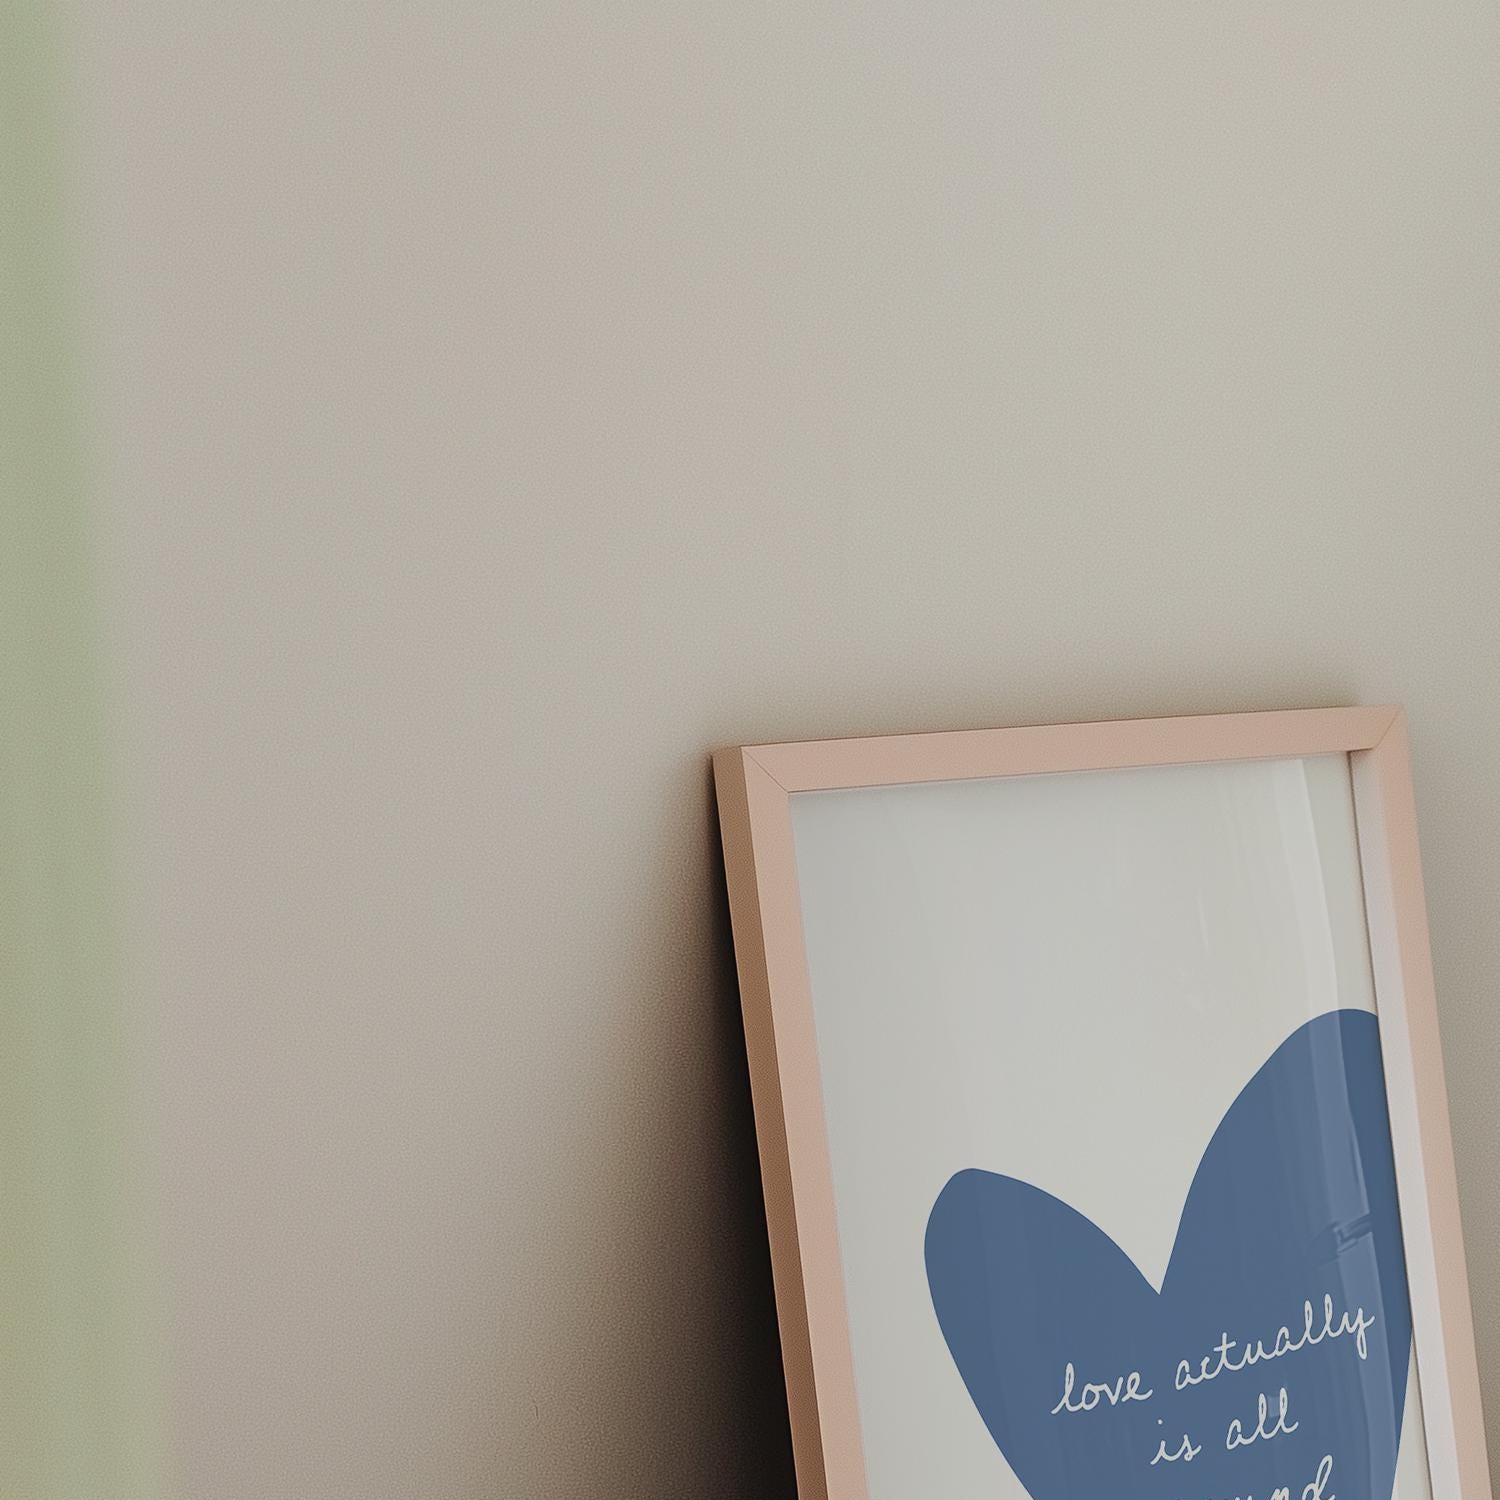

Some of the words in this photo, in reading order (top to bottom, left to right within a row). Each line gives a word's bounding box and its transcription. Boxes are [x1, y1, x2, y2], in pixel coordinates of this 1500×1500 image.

[1051, 1362, 1153, 1415] love
[1174, 1293, 1375, 1391] actually
[1150, 1419, 1202, 1465] is
[1226, 1387, 1299, 1450] all
